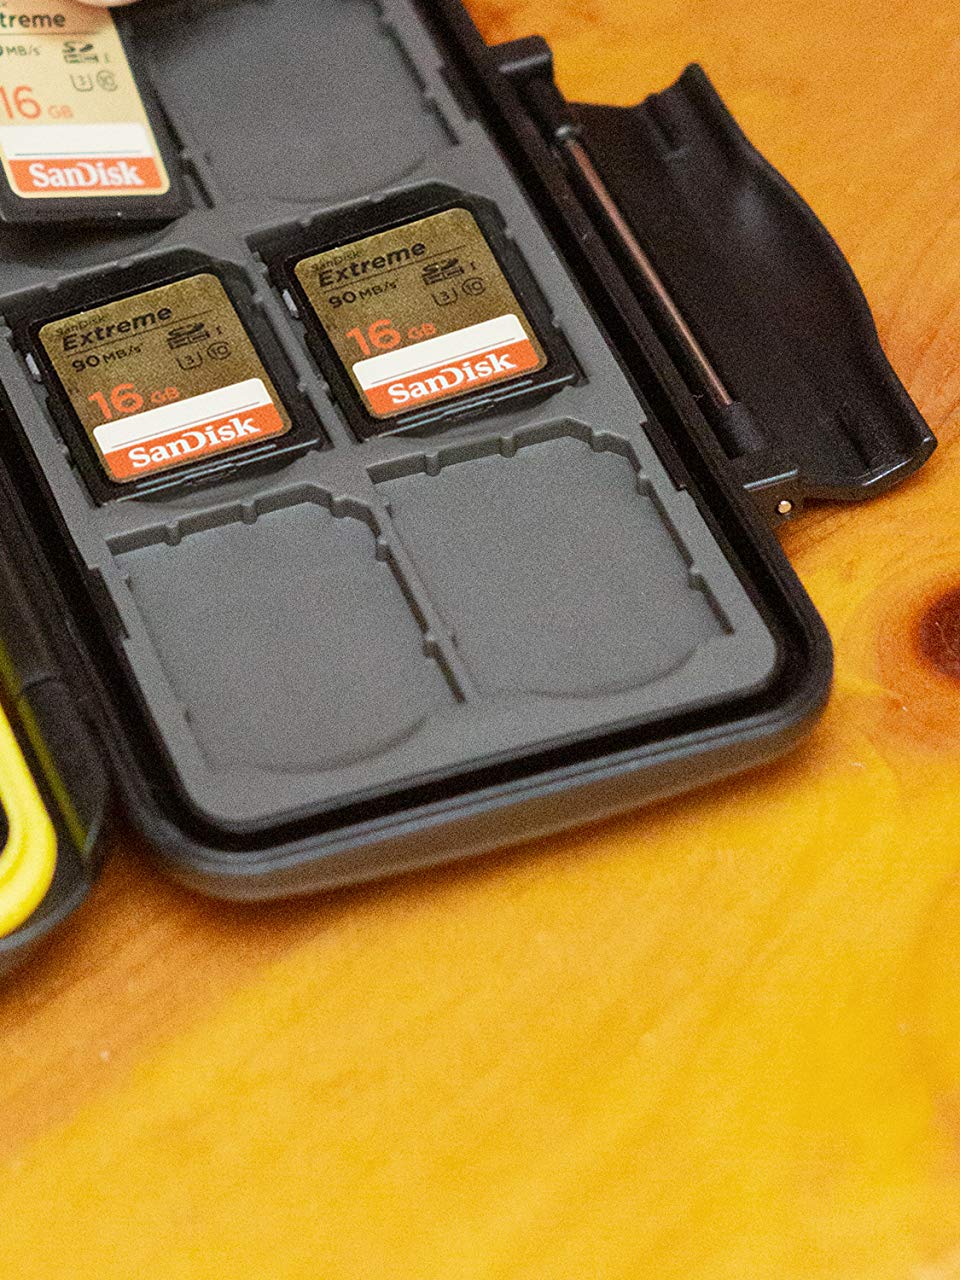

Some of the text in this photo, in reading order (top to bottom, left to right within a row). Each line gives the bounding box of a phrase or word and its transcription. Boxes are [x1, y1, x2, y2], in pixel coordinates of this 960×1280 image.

[28, 161, 145, 188] SanDisk
[318, 242, 426, 287] Extreme
[62, 306, 173, 352] Extreme
[345, 319, 436, 356] 16 GB
[88, 382, 180, 420] 16 GB
[387, 352, 517, 405] SanDisk
[127, 416, 260, 469] SanDisk
